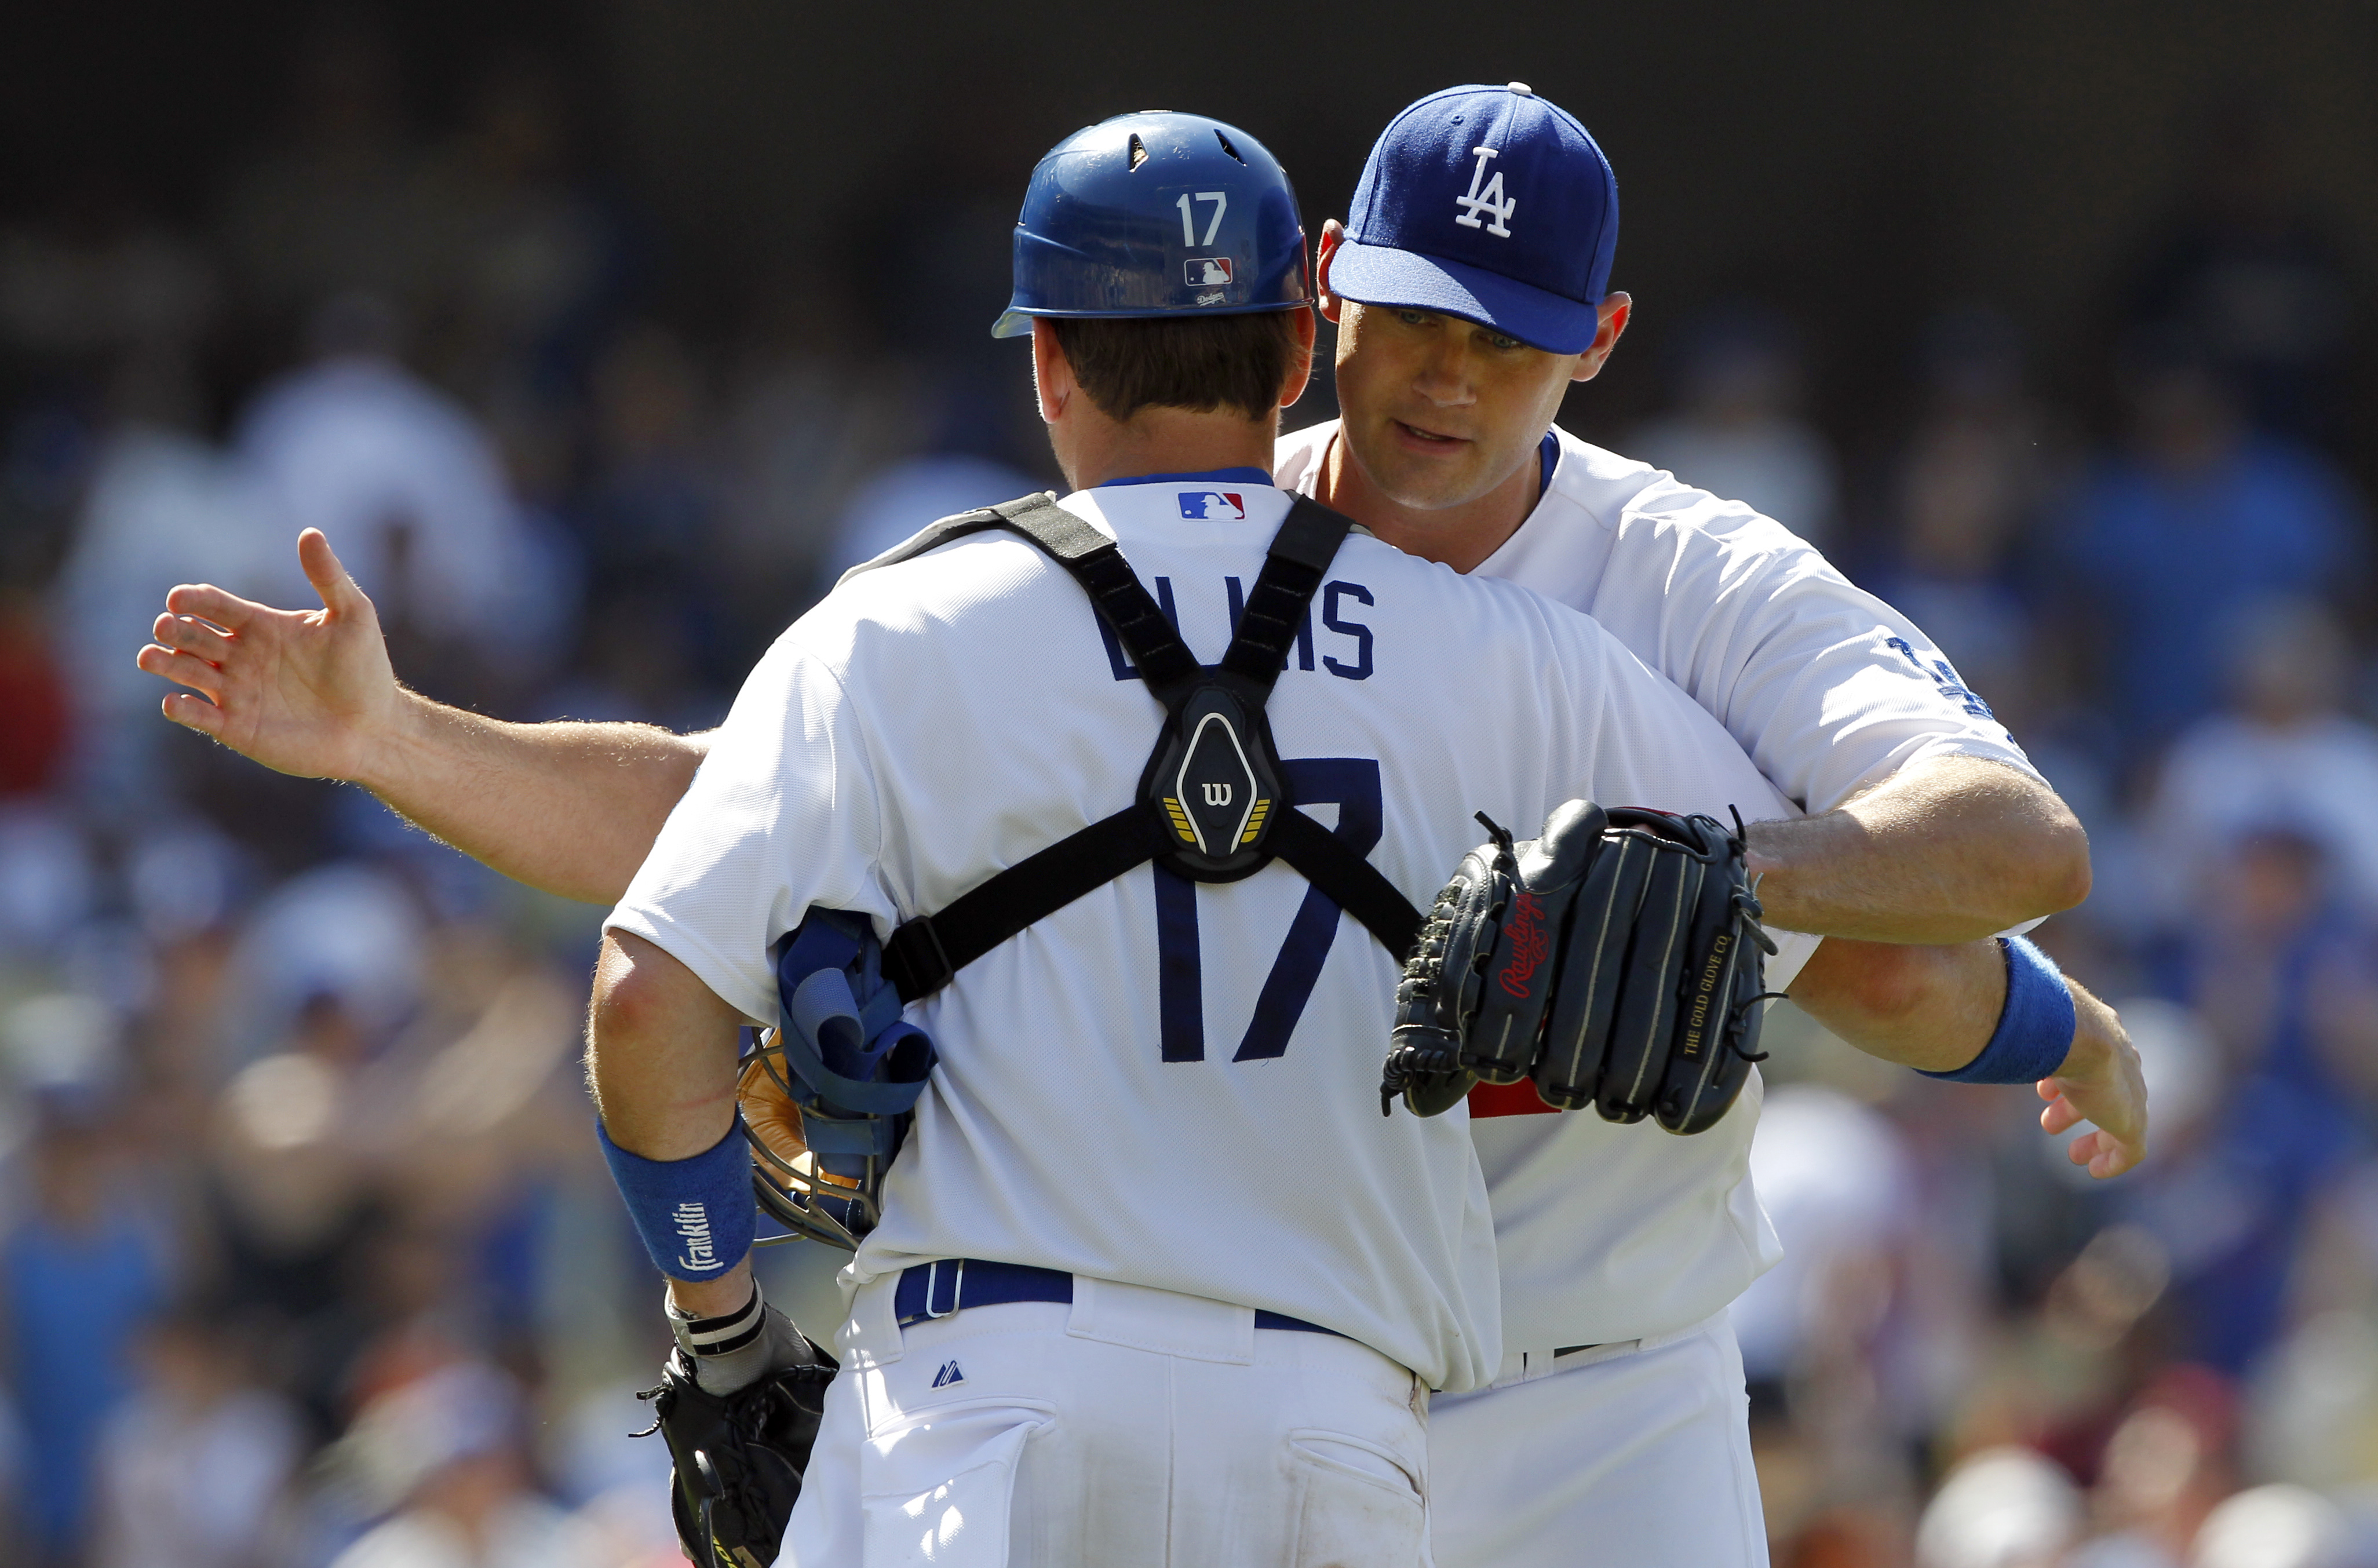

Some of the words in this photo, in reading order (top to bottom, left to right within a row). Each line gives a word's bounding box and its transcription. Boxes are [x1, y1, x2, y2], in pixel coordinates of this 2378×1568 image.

[1176, 191, 1227, 247] 17
[1455, 146, 1516, 238] LA
[1152, 757, 1384, 1063] 17
[1498, 892, 1546, 999] Rawlings
[1699, 954, 1723, 991] GLOVE
[1690, 994, 1709, 1027] GOLD
[1684, 1030, 1701, 1055] THE
